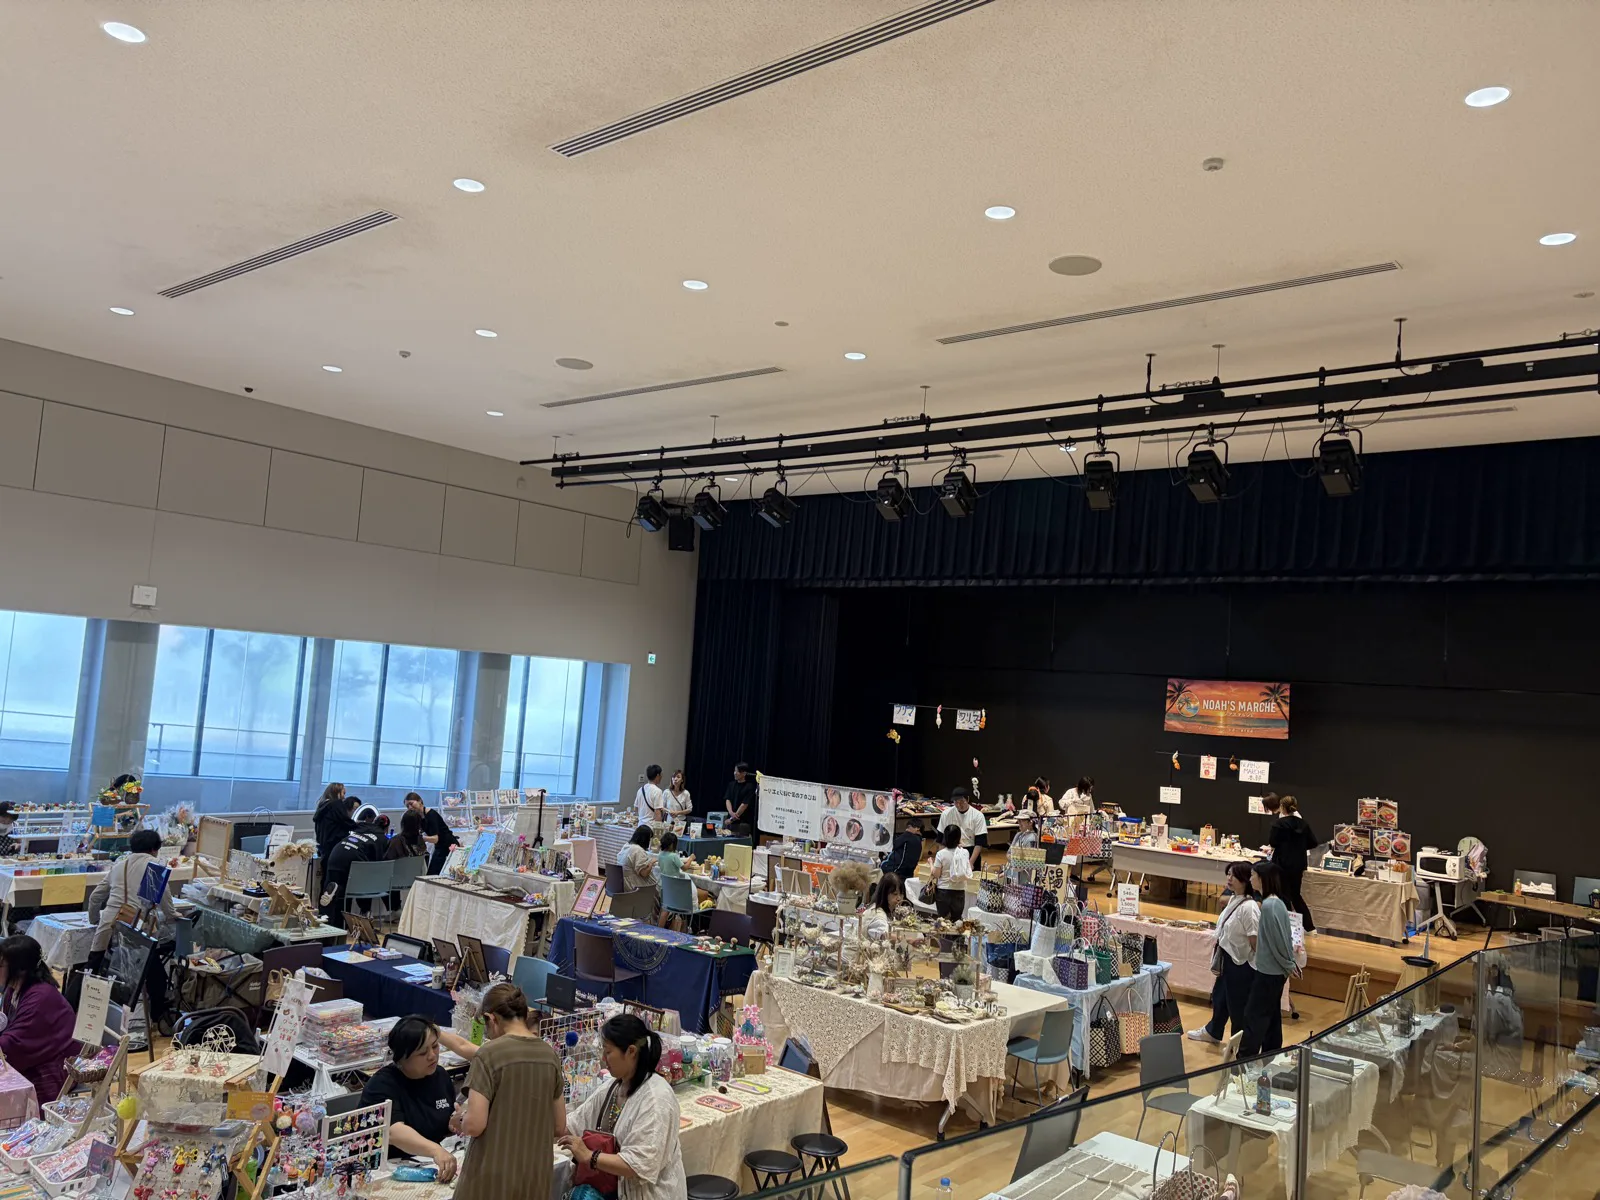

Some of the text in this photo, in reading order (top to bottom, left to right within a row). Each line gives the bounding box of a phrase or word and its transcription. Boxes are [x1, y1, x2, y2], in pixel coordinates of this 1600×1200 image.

[1202, 699, 1276, 713] NOAH'S MARCHE
[1243, 768, 1266, 776] MARCHE
